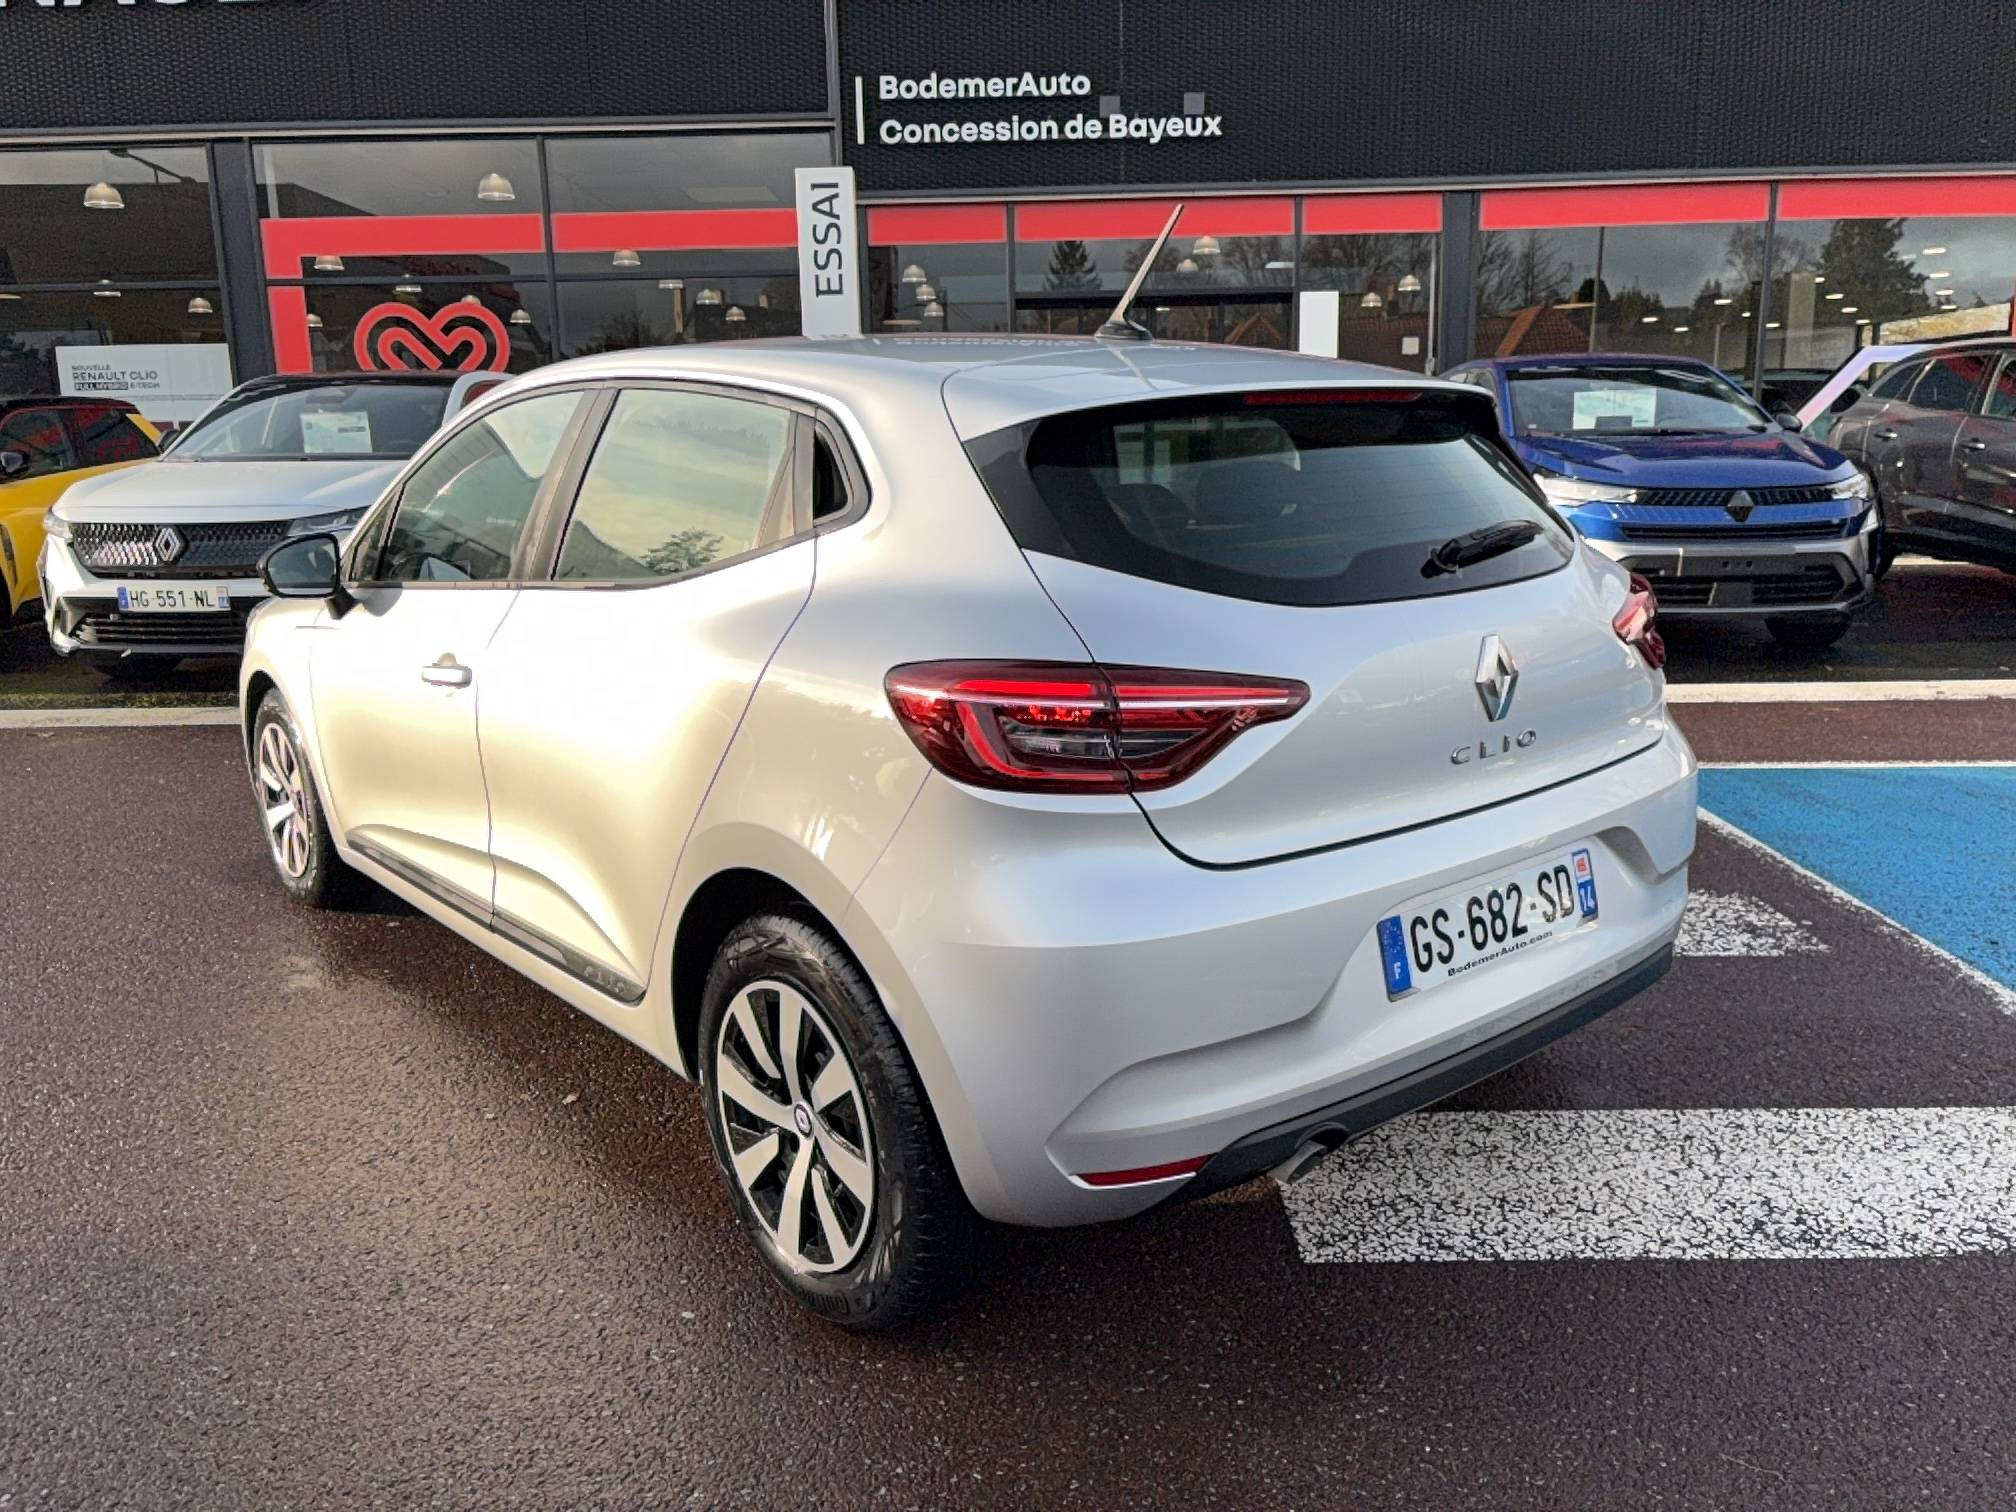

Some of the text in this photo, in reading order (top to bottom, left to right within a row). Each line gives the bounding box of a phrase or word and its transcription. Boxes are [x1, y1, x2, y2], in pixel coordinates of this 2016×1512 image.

[879, 72, 1091, 99] BodemerAuto
[879, 113, 1223, 144] Concession de Bayeux
[810, 182, 844, 298] ESSAI
[72, 370, 159, 381] RENAULT CLIO
[1450, 728, 1536, 765] CLIO
[1580, 885, 1595, 912] 14
[1410, 864, 1575, 973] GS-682-SD
[1447, 931, 1552, 977] BodemerAuto.com
[1393, 963, 1401, 980] F
